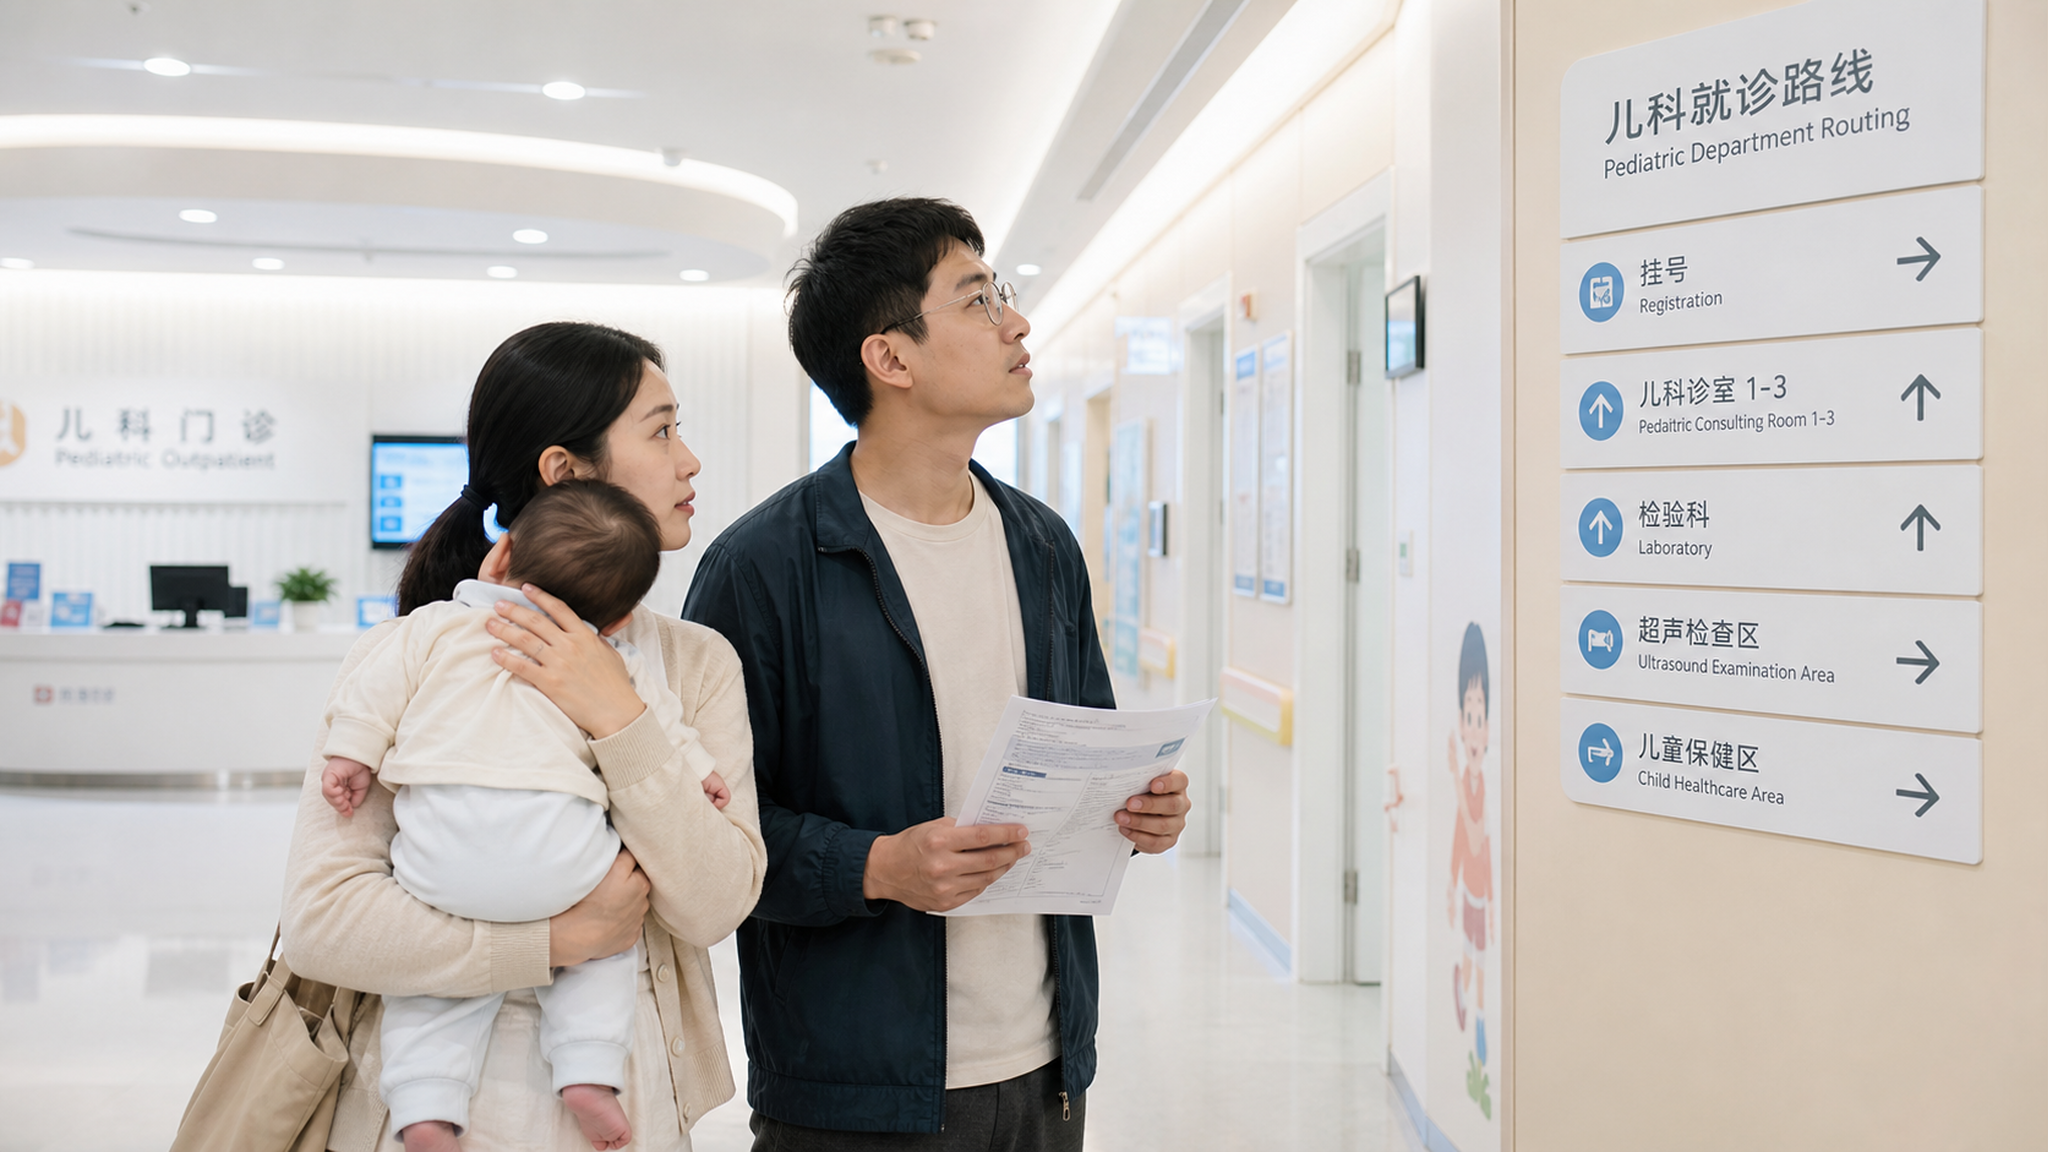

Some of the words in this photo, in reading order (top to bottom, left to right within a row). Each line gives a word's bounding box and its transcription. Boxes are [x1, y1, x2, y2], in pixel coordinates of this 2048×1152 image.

[1604, 48, 1875, 146] 儿科就诊路线
[1603, 147, 1686, 180] Pediatric
[1691, 122, 1815, 165] Department
[1821, 106, 1911, 139] Routing
[1639, 256, 1689, 288] 挂号
[1639, 292, 1723, 316] Registration
[1639, 375, 1736, 408] 儿科诊室
[1746, 374, 1788, 401] 1-3
[55, 406, 277, 445] 儿科门诊
[1694, 414, 1764, 433] Consulting
[1768, 412, 1807, 428] Room
[1811, 409, 1835, 426] 1-3
[55, 449, 151, 468] Pediatric
[161, 449, 275, 473] Outpatient
[1638, 500, 1711, 529] 检验科
[1638, 539, 1713, 560] Laboratory
[1638, 615, 1760, 650] 超声检查区
[1638, 654, 1708, 675] Ultrasound
[1712, 658, 1797, 681] Examination
[1800, 665, 1835, 683] Area
[1638, 732, 1760, 774] 儿童保健区
[1638, 769, 1671, 790] Child
[1674, 774, 1748, 801] Healthcare
[1750, 785, 1785, 805] Area
